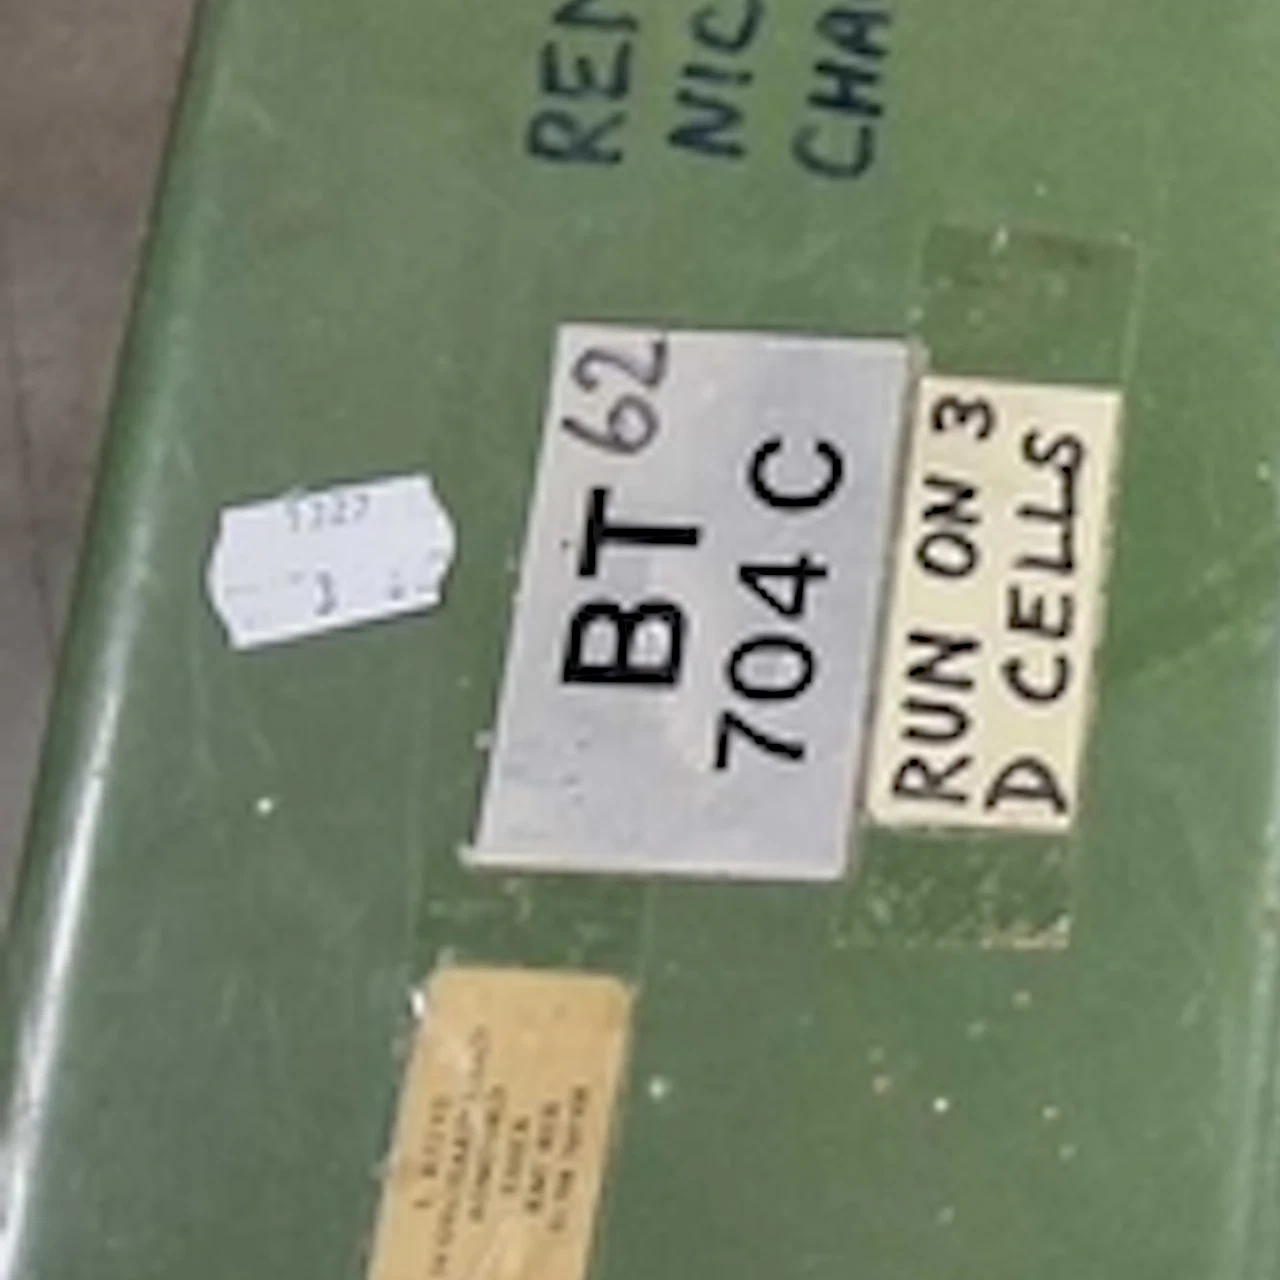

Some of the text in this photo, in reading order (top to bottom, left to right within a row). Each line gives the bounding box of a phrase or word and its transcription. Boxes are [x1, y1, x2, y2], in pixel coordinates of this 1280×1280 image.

[560, 338, 668, 456] 62
[560, 486, 703, 686] BT
[890, 395, 998, 805] RUN ON 3
[983, 429, 1087, 815] D CELLS
